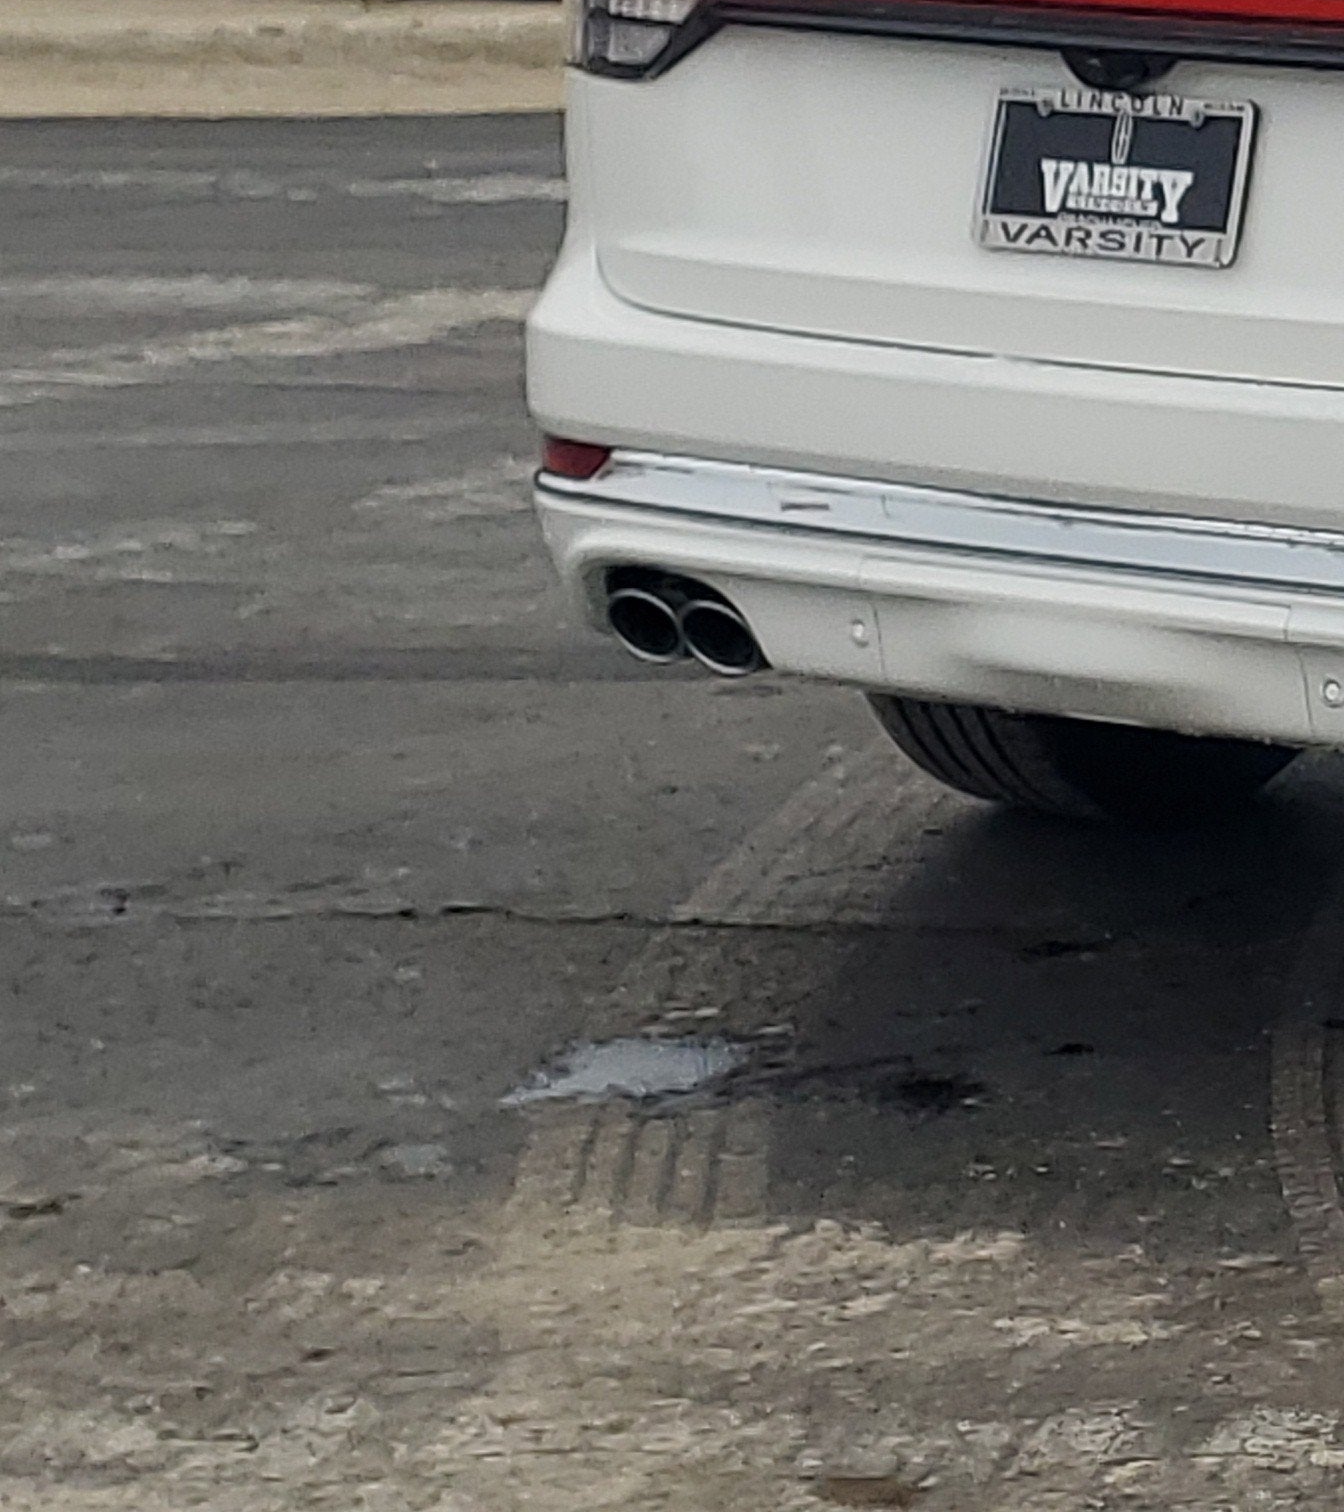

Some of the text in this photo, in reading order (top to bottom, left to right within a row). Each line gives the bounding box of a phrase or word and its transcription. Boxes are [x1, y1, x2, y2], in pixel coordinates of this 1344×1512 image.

[1059, 90, 1185, 116] LINCOLN
[1041, 157, 1195, 223] VARSITY
[1000, 220, 1205, 259] VARSITY
